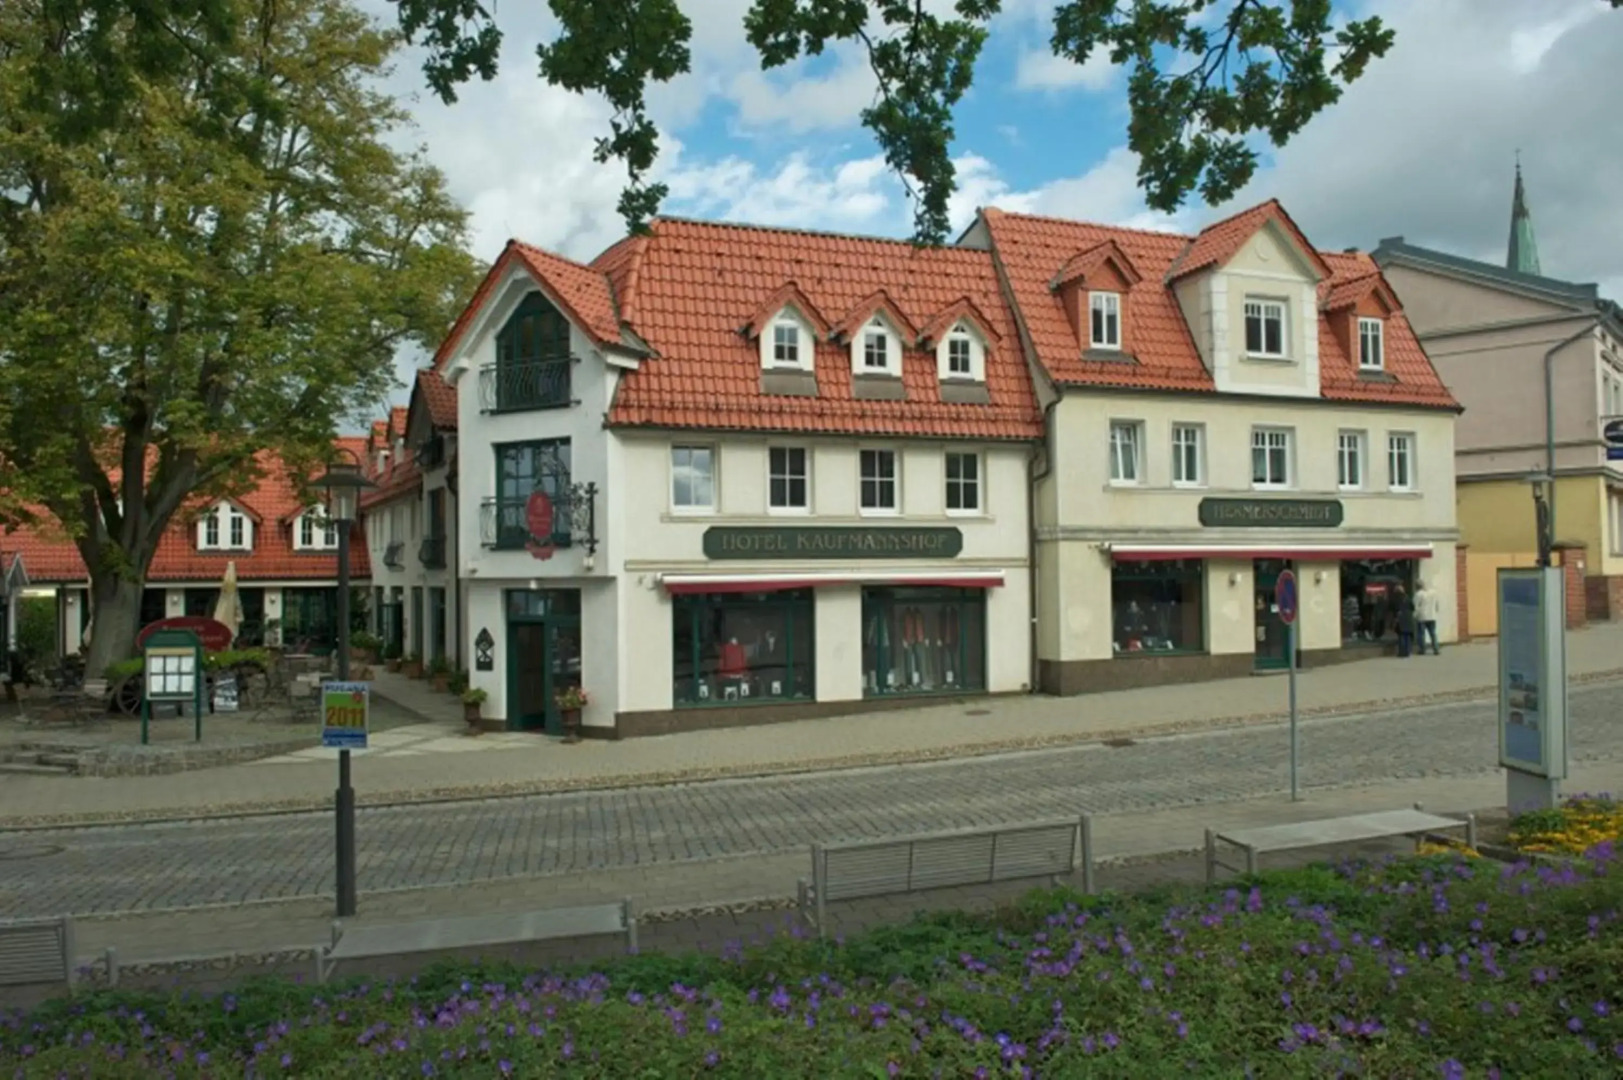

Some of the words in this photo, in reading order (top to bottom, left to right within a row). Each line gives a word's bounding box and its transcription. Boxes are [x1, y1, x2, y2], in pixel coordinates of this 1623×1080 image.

[721, 534, 788, 550] HOTEL
[796, 534, 949, 551] KAUFMANNSHOF
[325, 706, 366, 727] 2011
